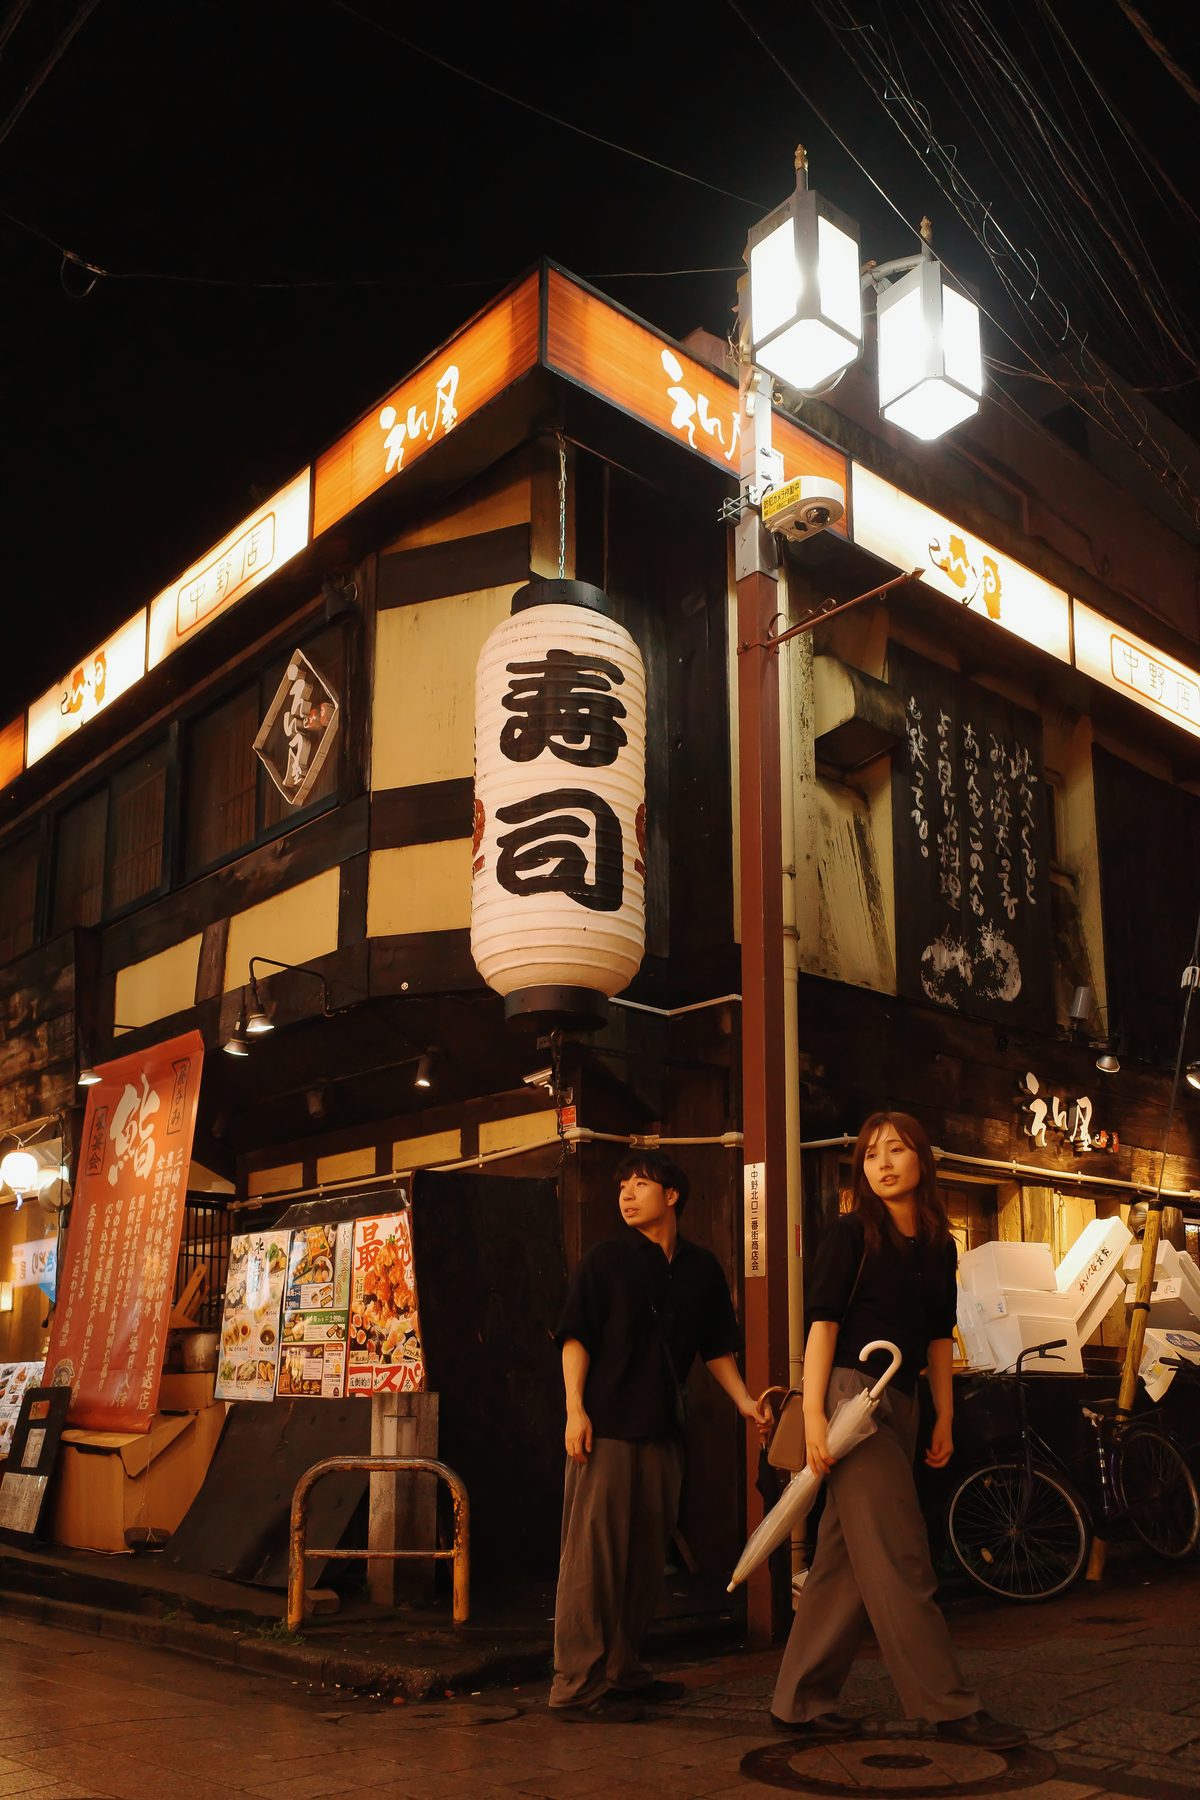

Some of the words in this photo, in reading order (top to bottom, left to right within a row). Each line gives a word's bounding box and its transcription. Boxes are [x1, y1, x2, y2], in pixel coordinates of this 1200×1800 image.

[661, 349, 741, 460] えん
[189, 529, 262, 620] 中野店
[1122, 648, 1192, 711] 中野店
[495, 648, 629, 913] 寿司
[108, 1072, 161, 1188] 鮨
[750, 1170, 759, 1271] 中野北口二番街商店会
